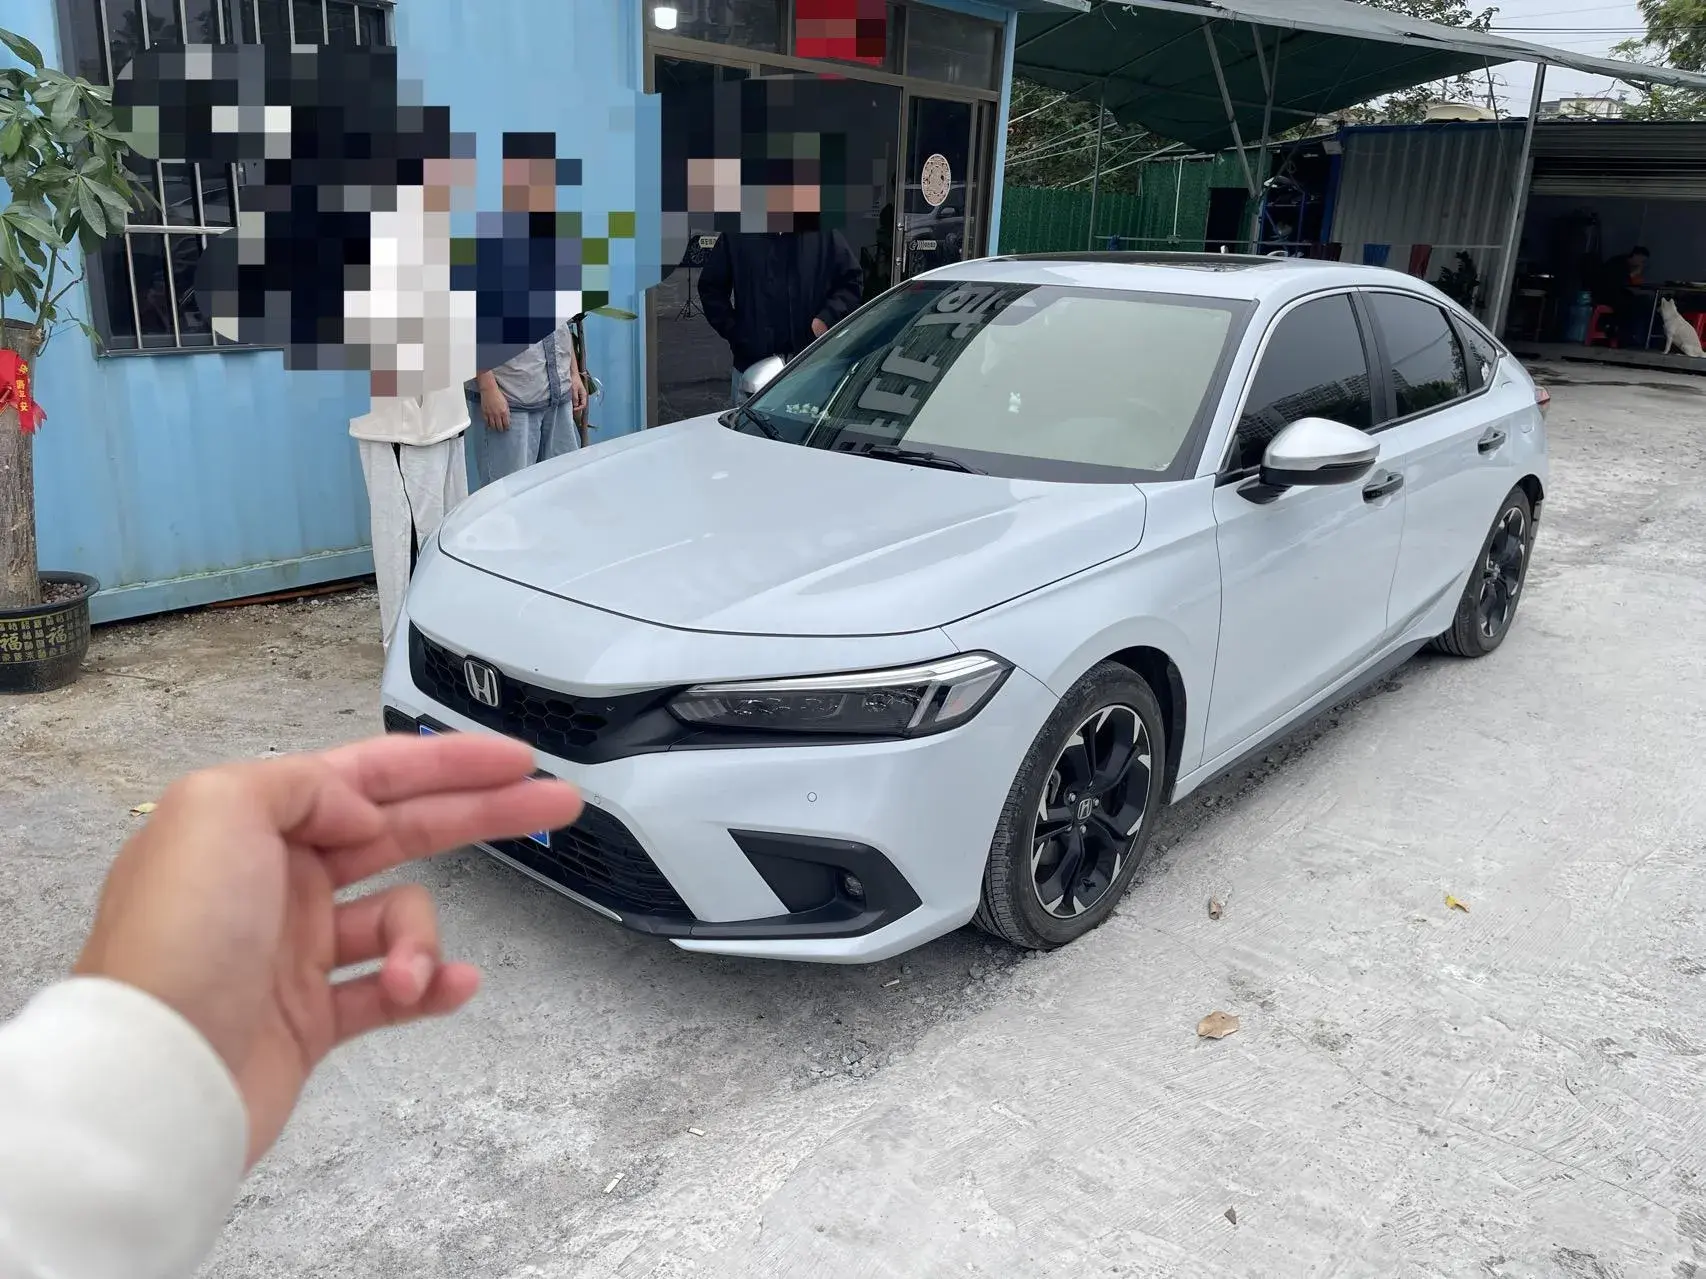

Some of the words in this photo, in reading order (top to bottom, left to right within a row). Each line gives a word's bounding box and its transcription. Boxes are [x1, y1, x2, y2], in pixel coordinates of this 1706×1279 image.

[0, 632, 23, 652] 福
[46, 624, 67, 646] 福
[465, 661, 497, 706] H
